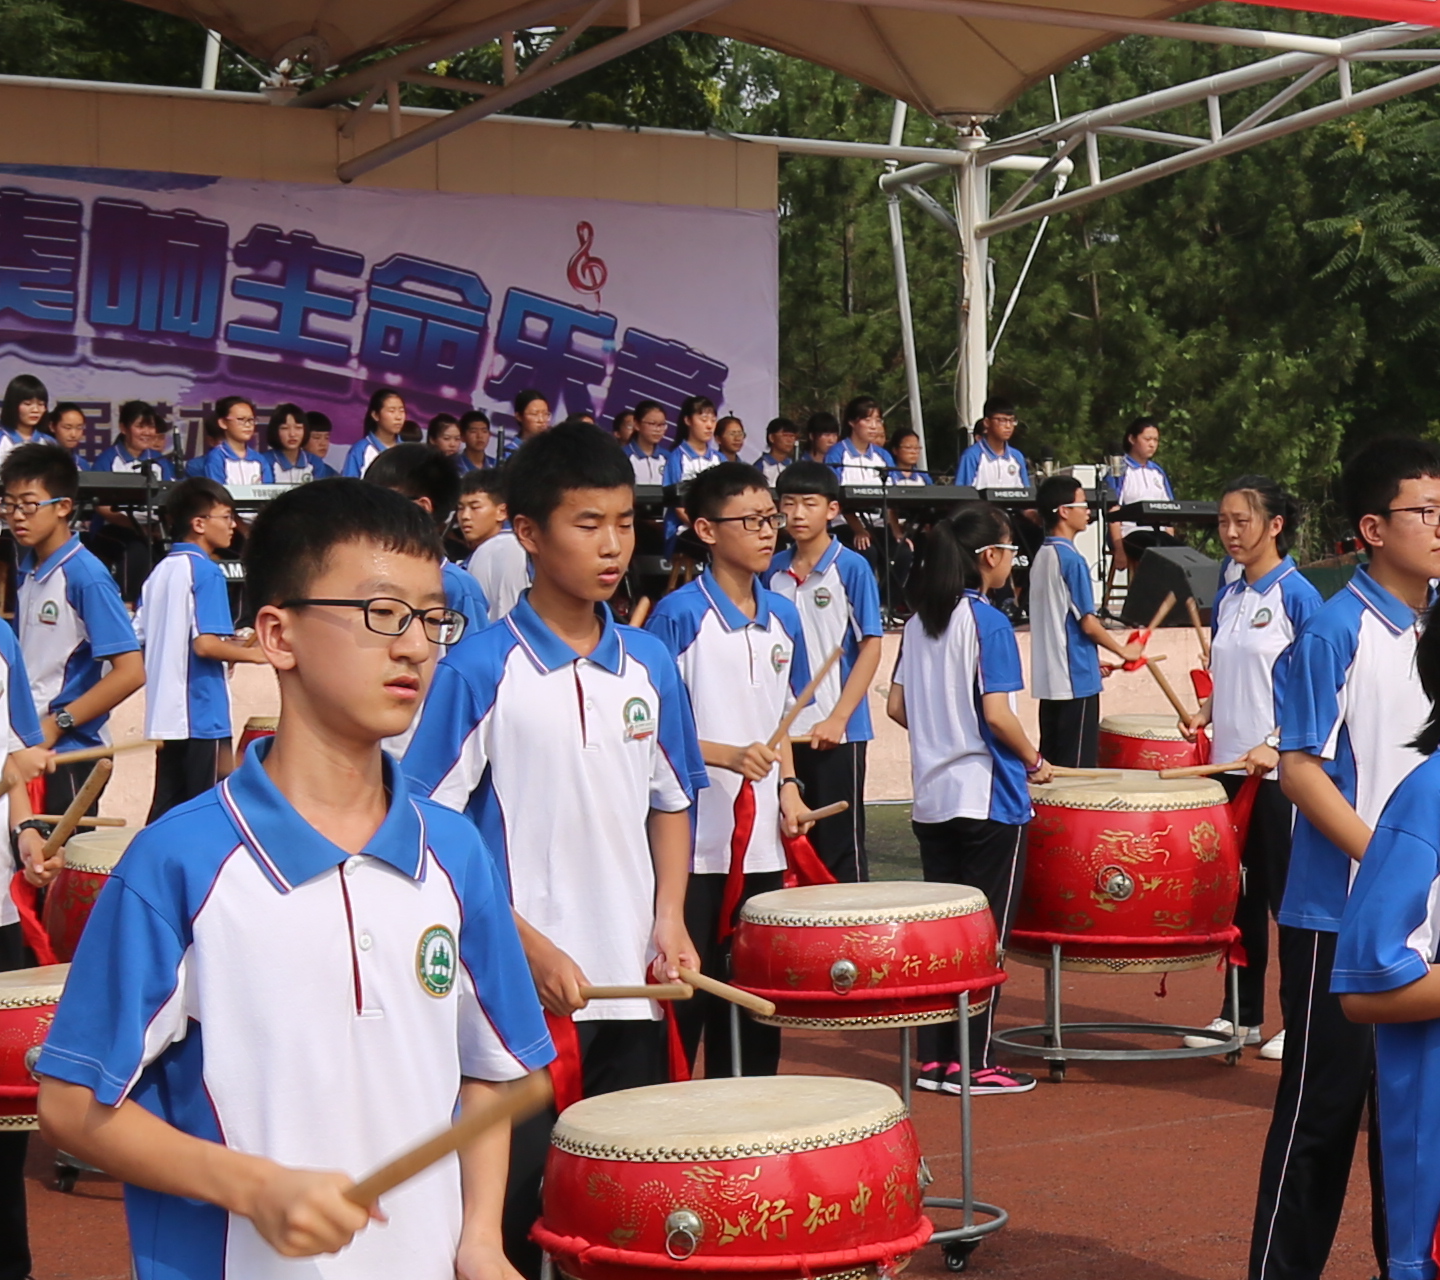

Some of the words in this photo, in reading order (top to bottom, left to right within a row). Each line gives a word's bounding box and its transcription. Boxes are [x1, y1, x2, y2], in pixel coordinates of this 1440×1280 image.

[1149, 502, 1181, 510] MEDELI
[753, 1180, 899, 1241] 行知中学
